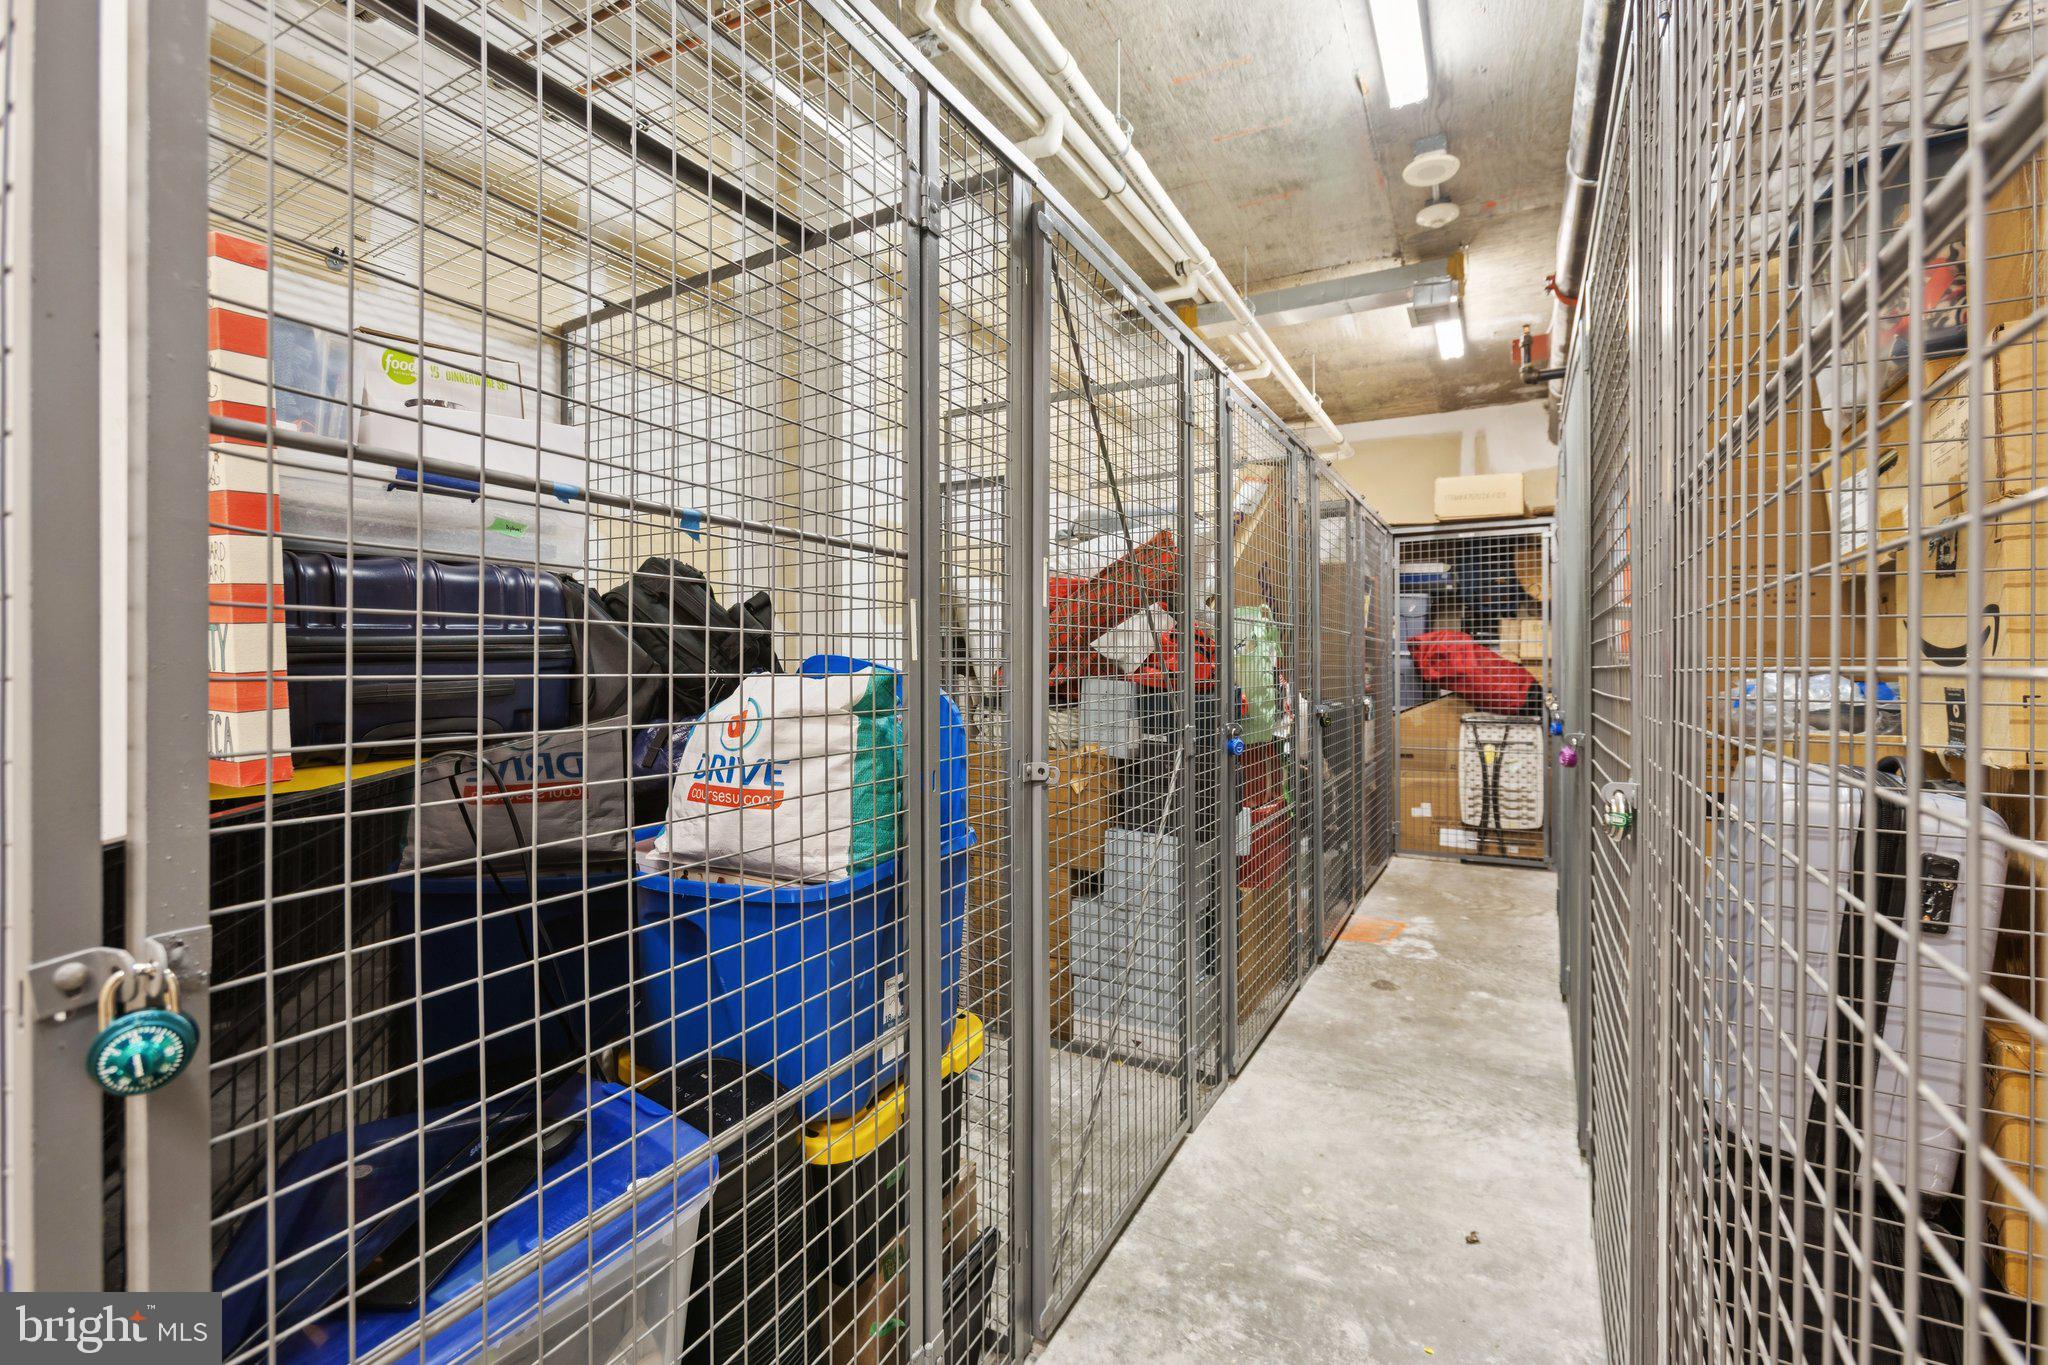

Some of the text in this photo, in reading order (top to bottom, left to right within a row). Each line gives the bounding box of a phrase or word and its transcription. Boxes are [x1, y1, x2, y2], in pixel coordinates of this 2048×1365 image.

[445, 371, 495, 389] DINNERWRE
[208, 623, 229, 672] TY
[693, 753, 790, 787] DRIVE
[691, 787, 773, 806] coursesucom
